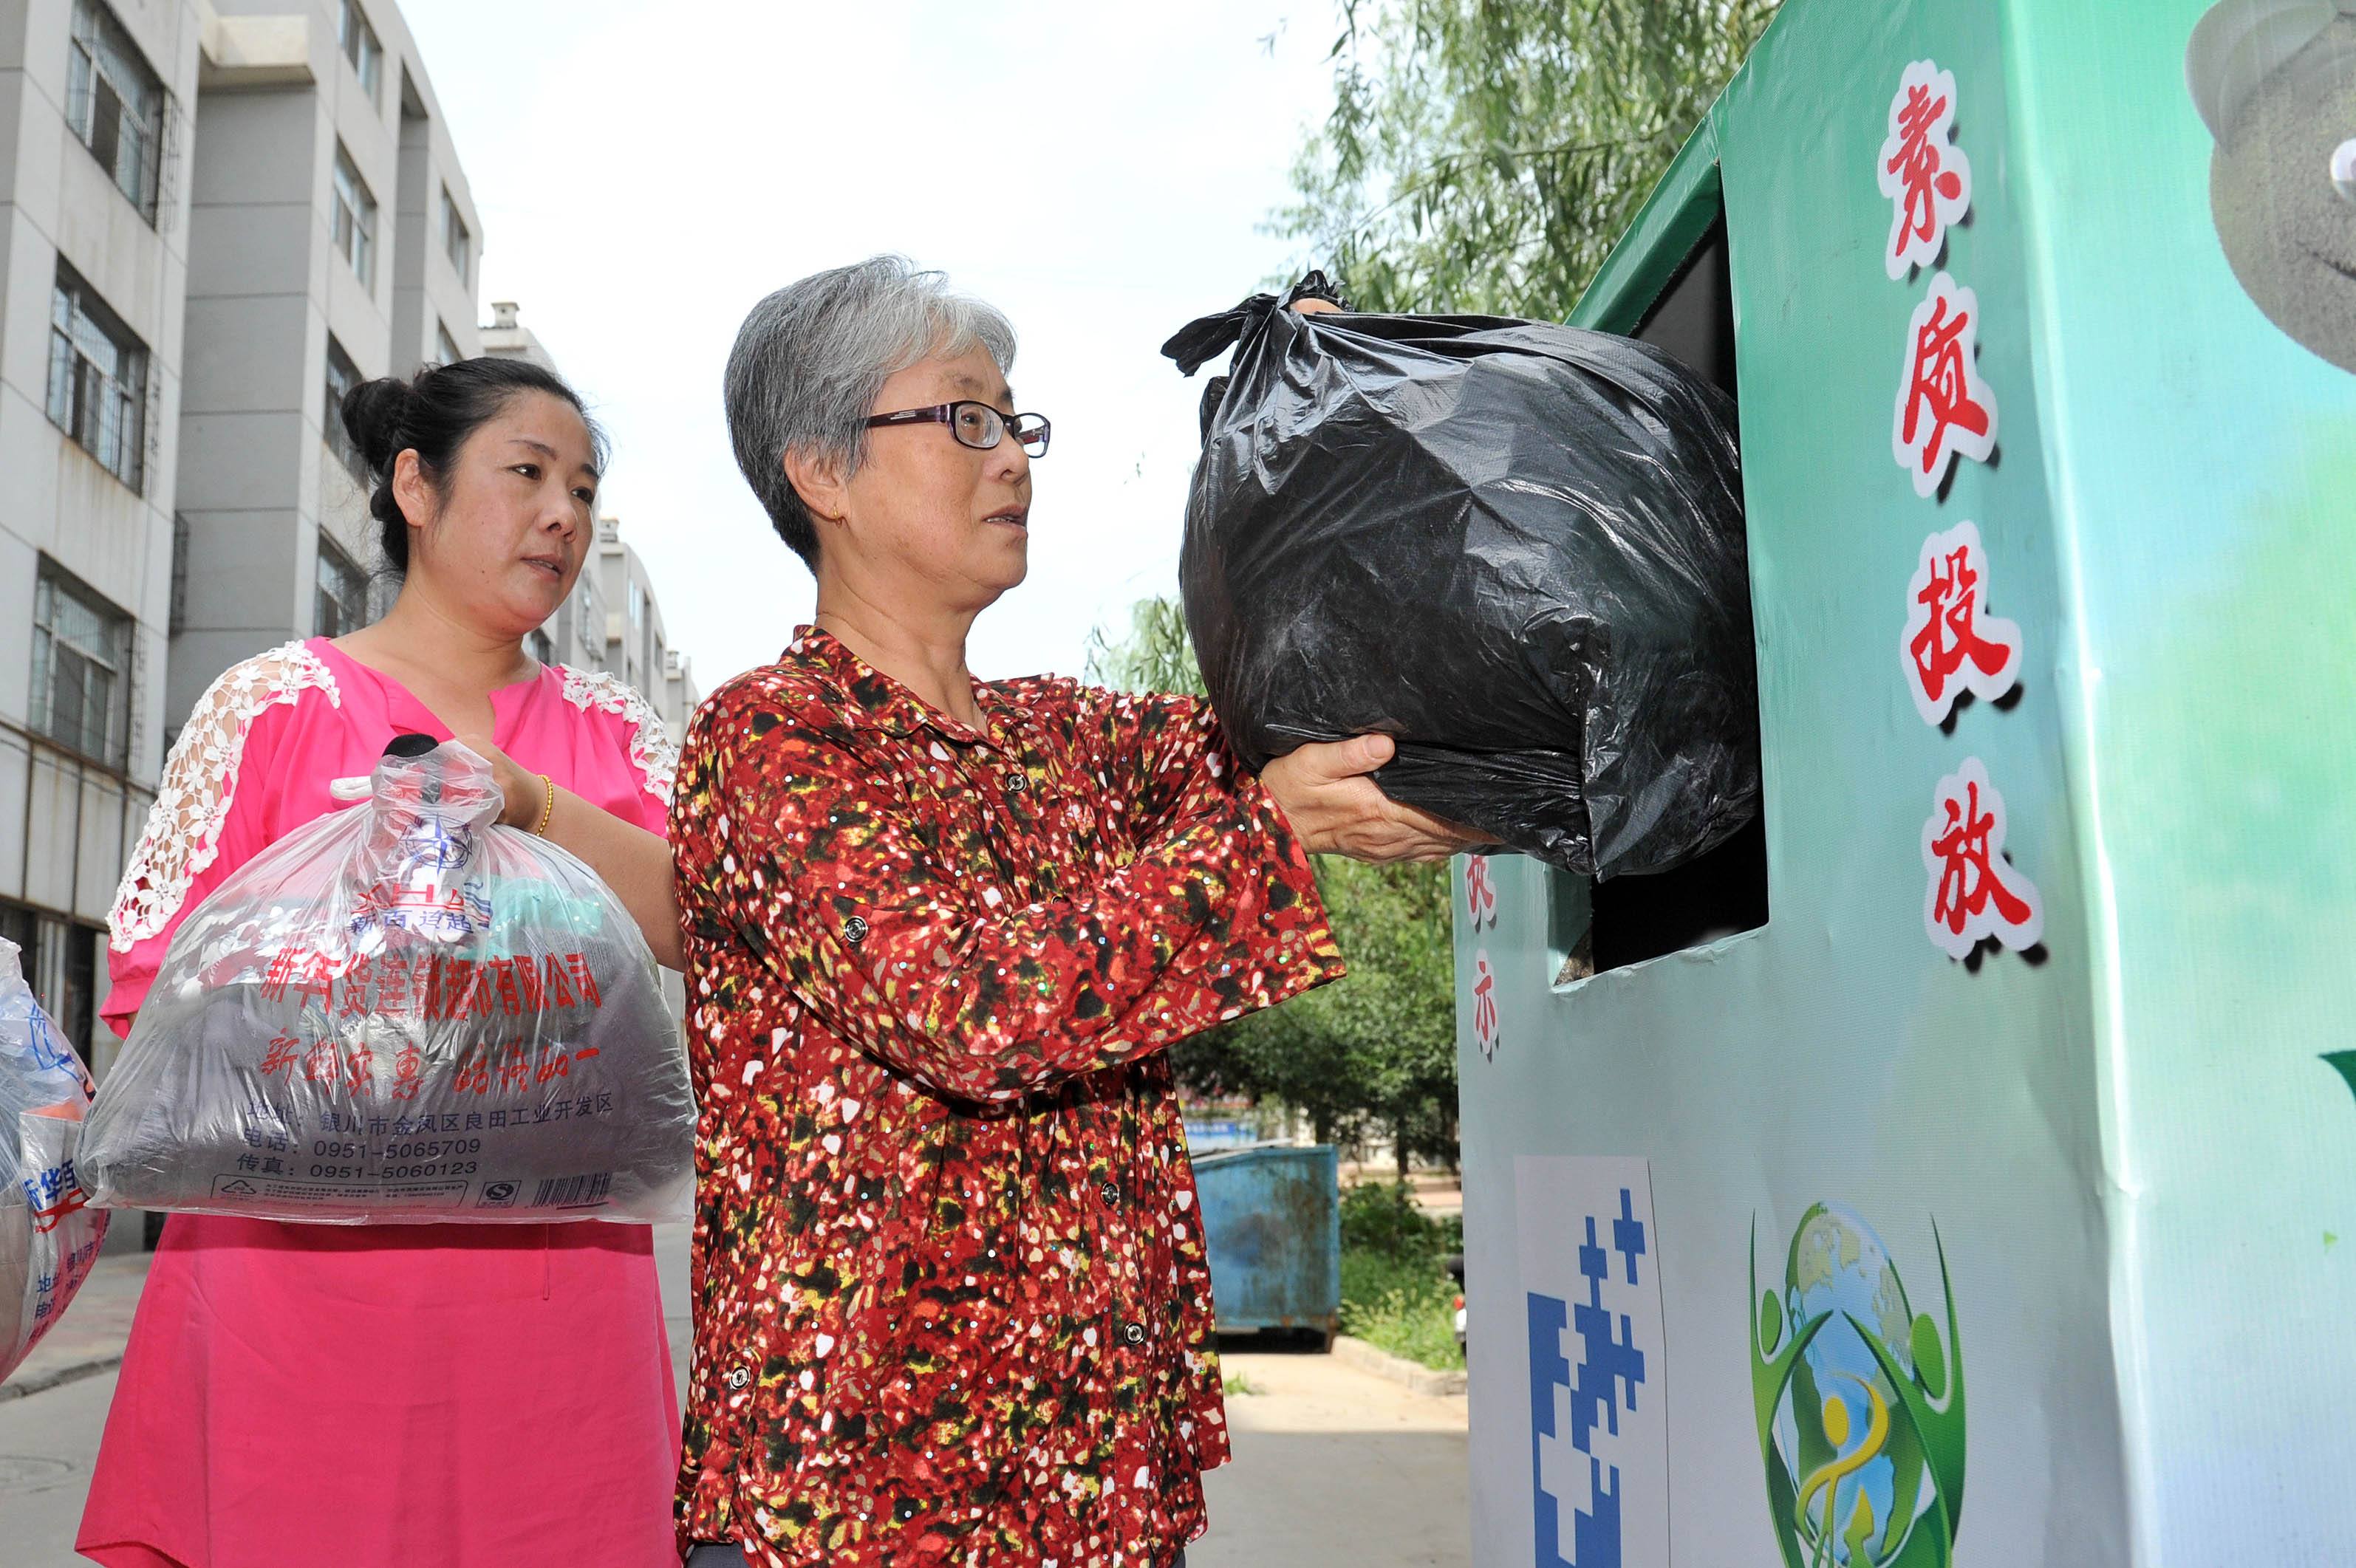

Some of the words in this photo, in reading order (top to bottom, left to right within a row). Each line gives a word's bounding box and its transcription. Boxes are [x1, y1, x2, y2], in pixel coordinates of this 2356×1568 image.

[1887, 83, 2032, 935] 素质投放
[320, 1093, 613, 1136] 银川市金凤区良田工业开发区
[310, 1161, 477, 1179] 0951-5060123
